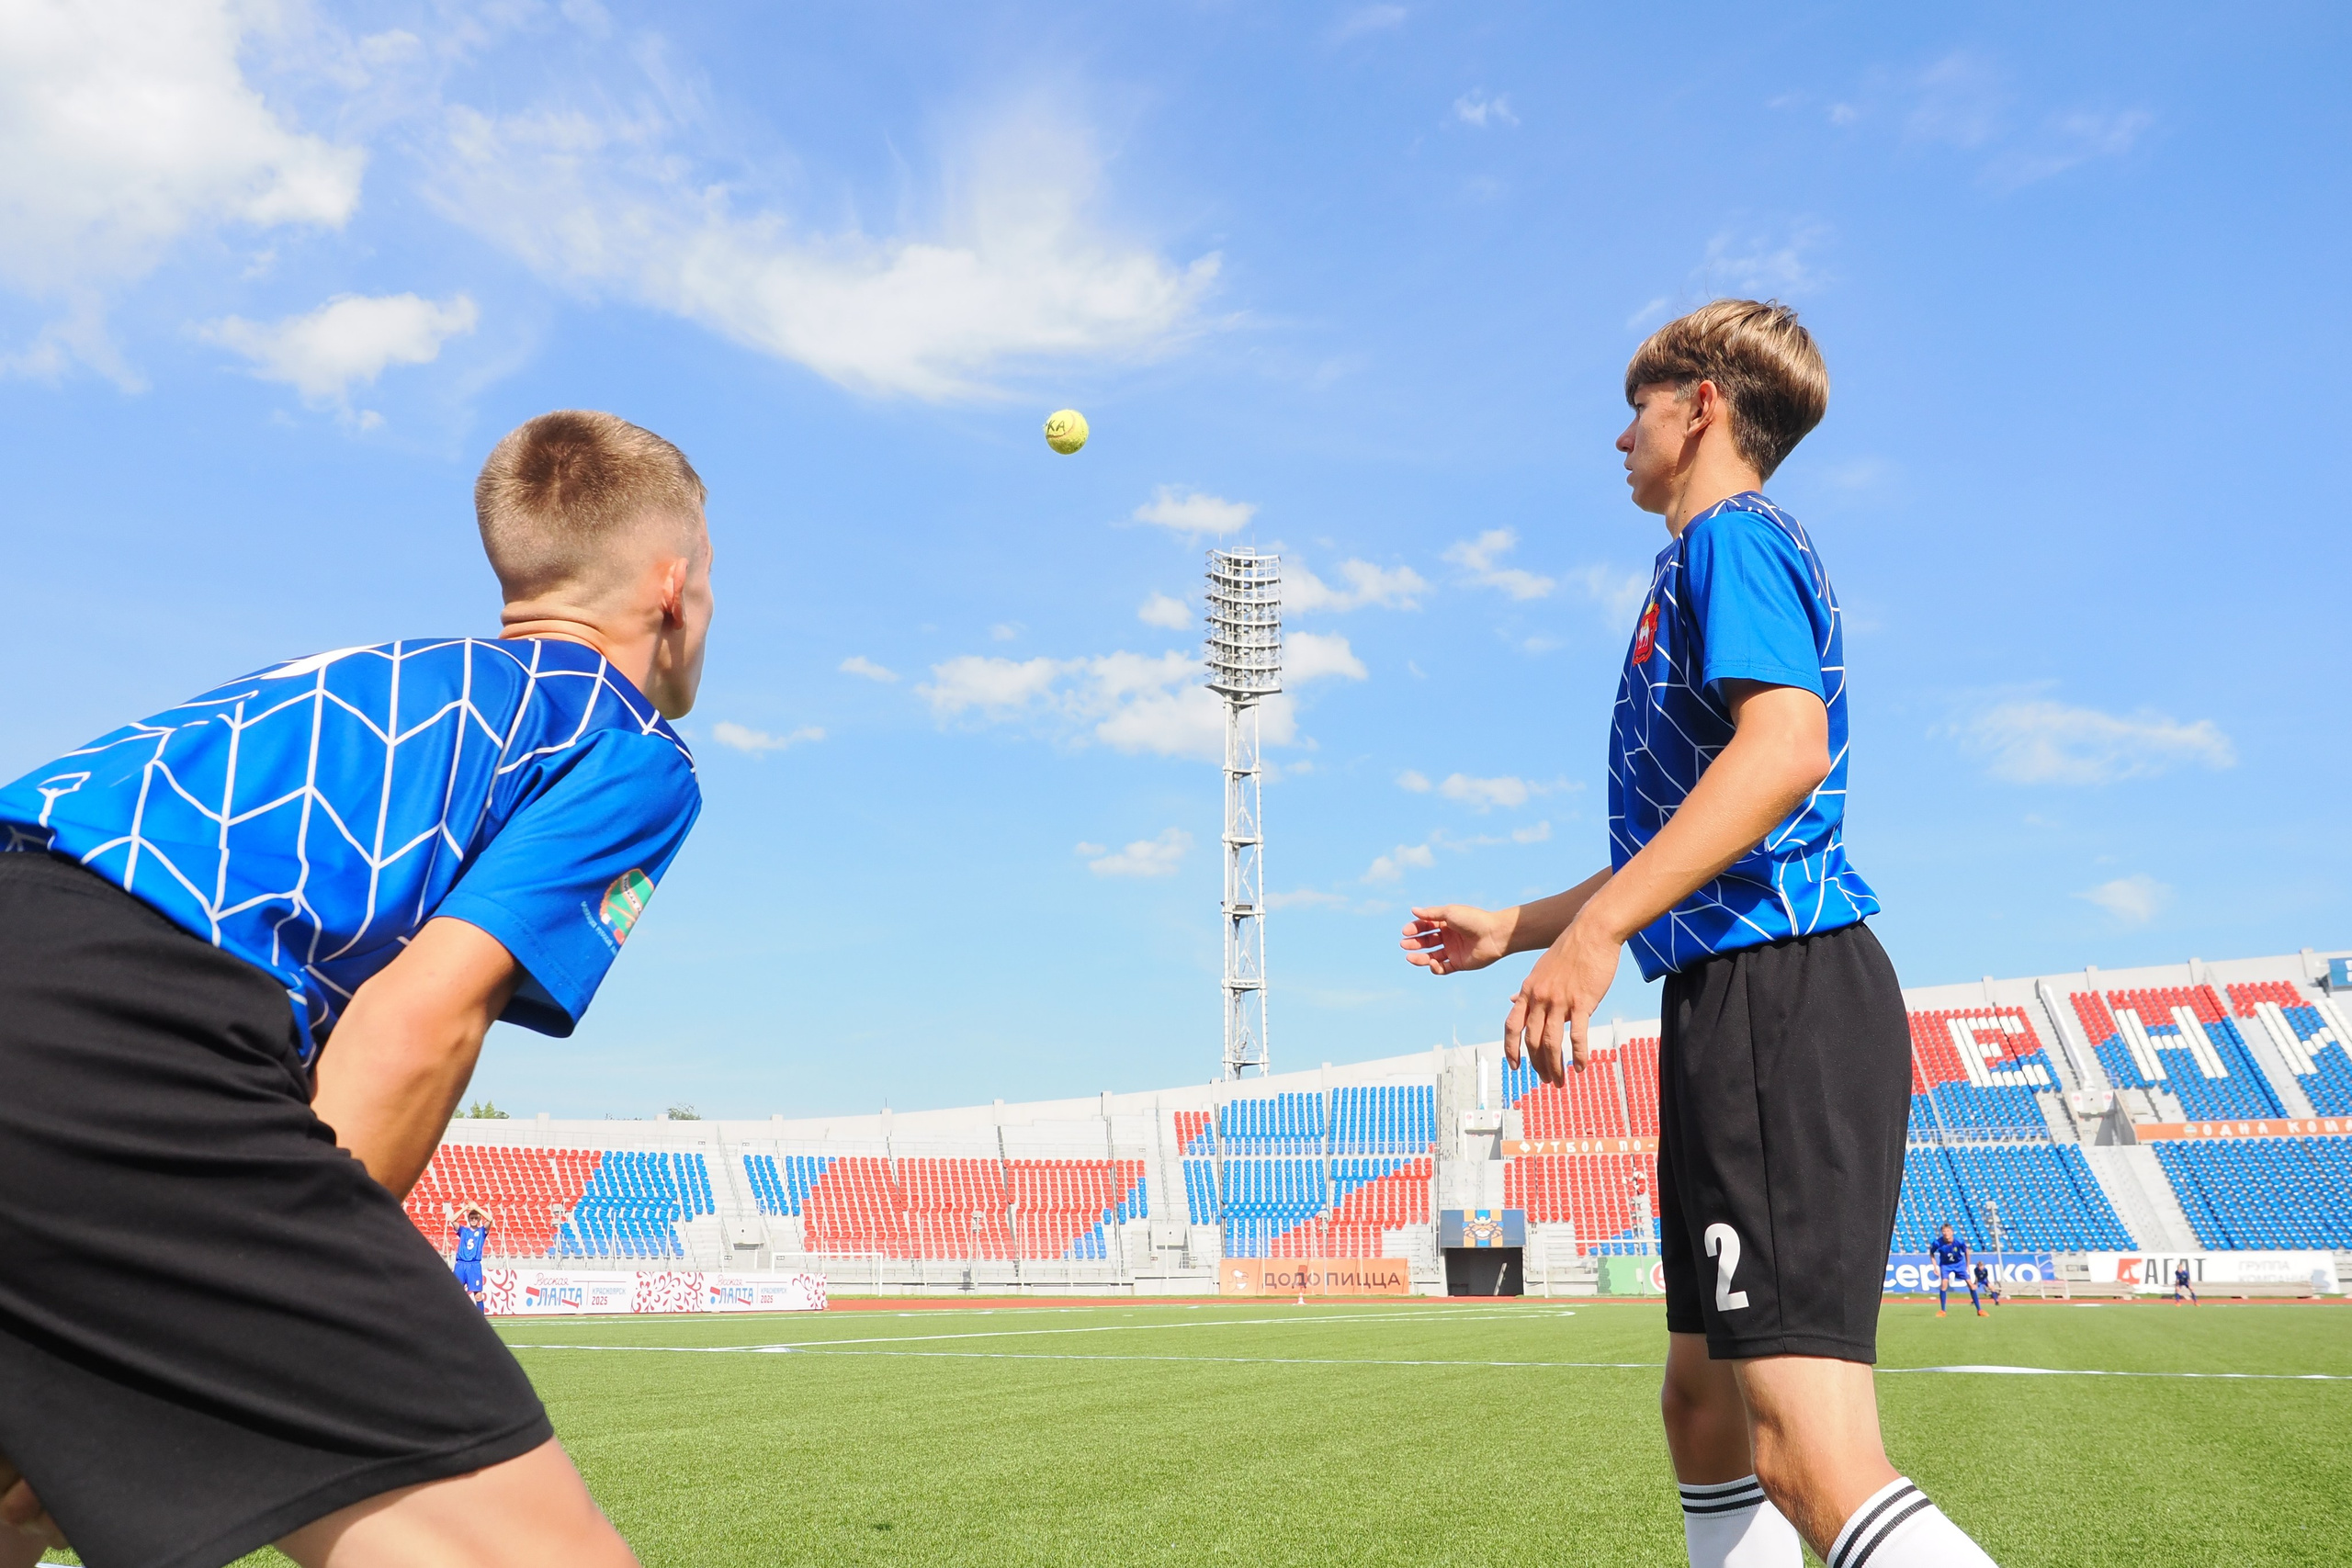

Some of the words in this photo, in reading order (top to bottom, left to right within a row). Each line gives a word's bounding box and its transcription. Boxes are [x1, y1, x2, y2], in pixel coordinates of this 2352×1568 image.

[2202, 1121, 2269, 1136] ОДНА
[1519, 1140, 1604, 1154] ФУТБОЛ
[467, 1238, 475, 1250] 5
[1947, 1252, 1955, 1262] 2
[1704, 1223, 1749, 1312] 2
[1261, 1272, 1321, 1290] ДОДО
[1326, 1272, 1401, 1290] ПИЦЦА
[537, 1287, 582, 1306] ЛАПТА
[592, 1287, 627, 1295] КРАСНОЯРСК
[718, 1287, 753, 1304] ЛАПТА
[591, 1296, 608, 1305] 2025
[760, 1295, 774, 1303] 2025
